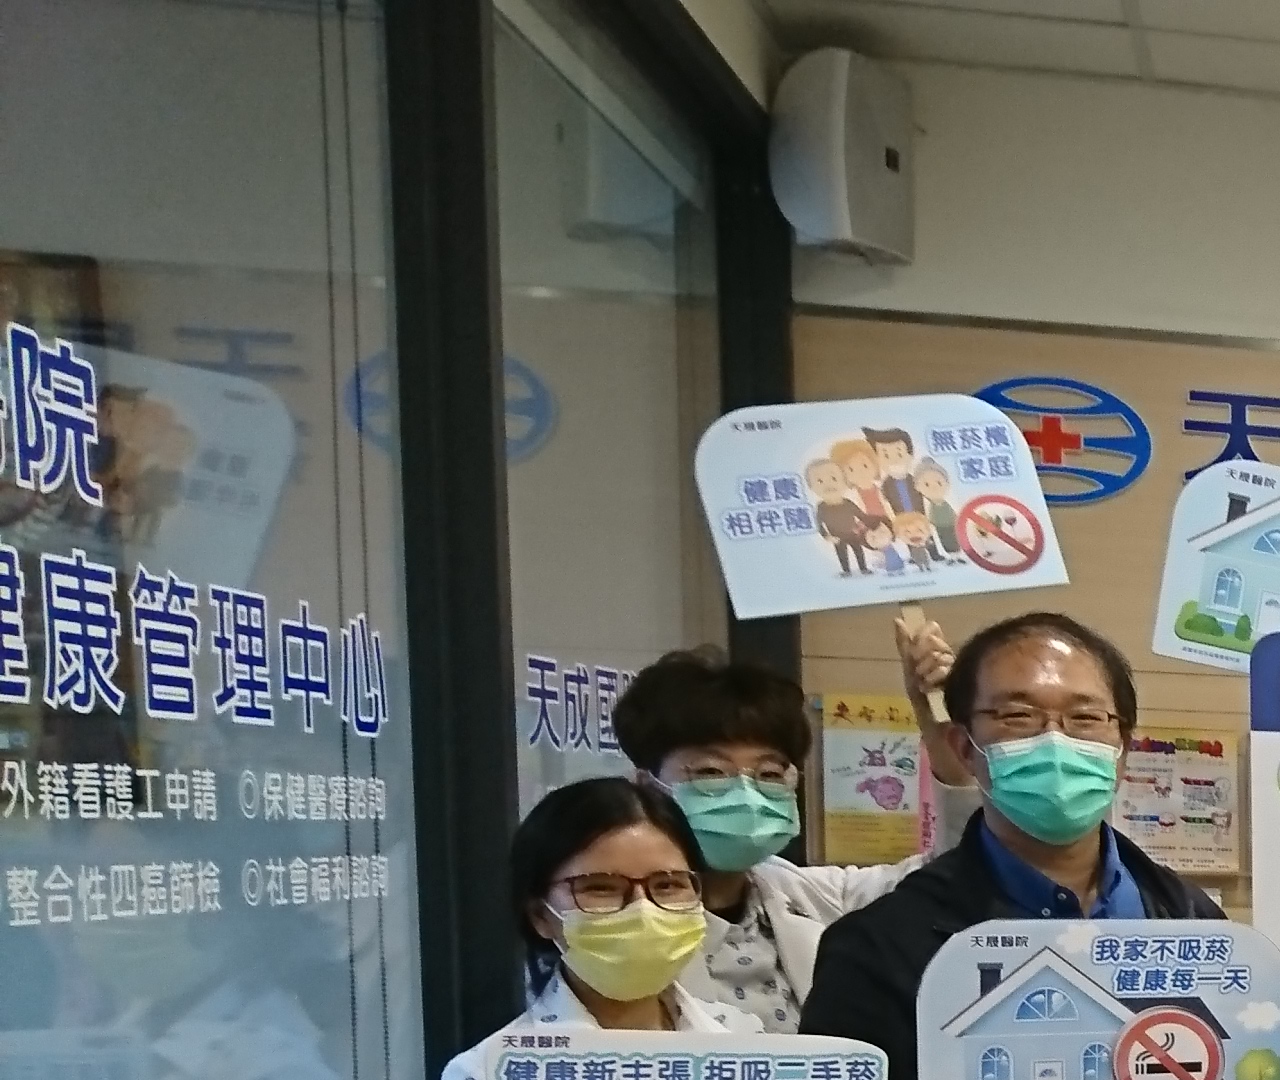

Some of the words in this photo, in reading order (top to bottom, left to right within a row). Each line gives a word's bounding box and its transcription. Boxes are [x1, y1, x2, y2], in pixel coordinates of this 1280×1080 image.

[0, 322, 103, 506] 院
[931, 423, 1010, 452] 無菸檳
[959, 456, 1014, 479] 家庭
[743, 475, 802, 502] 健康
[726, 507, 814, 536] 相伴隨
[527, 654, 638, 757] 天成國
[2, 760, 217, 820] 外籍看護工申請
[6, 861, 222, 927] 整合性四癌篩檢
[970, 935, 1029, 949] 天晟醫院
[1094, 937, 1231, 963] 我家不吸菸
[1115, 967, 1250, 993] 健康每一天
[502, 1035, 571, 1049] 天晟醫院
